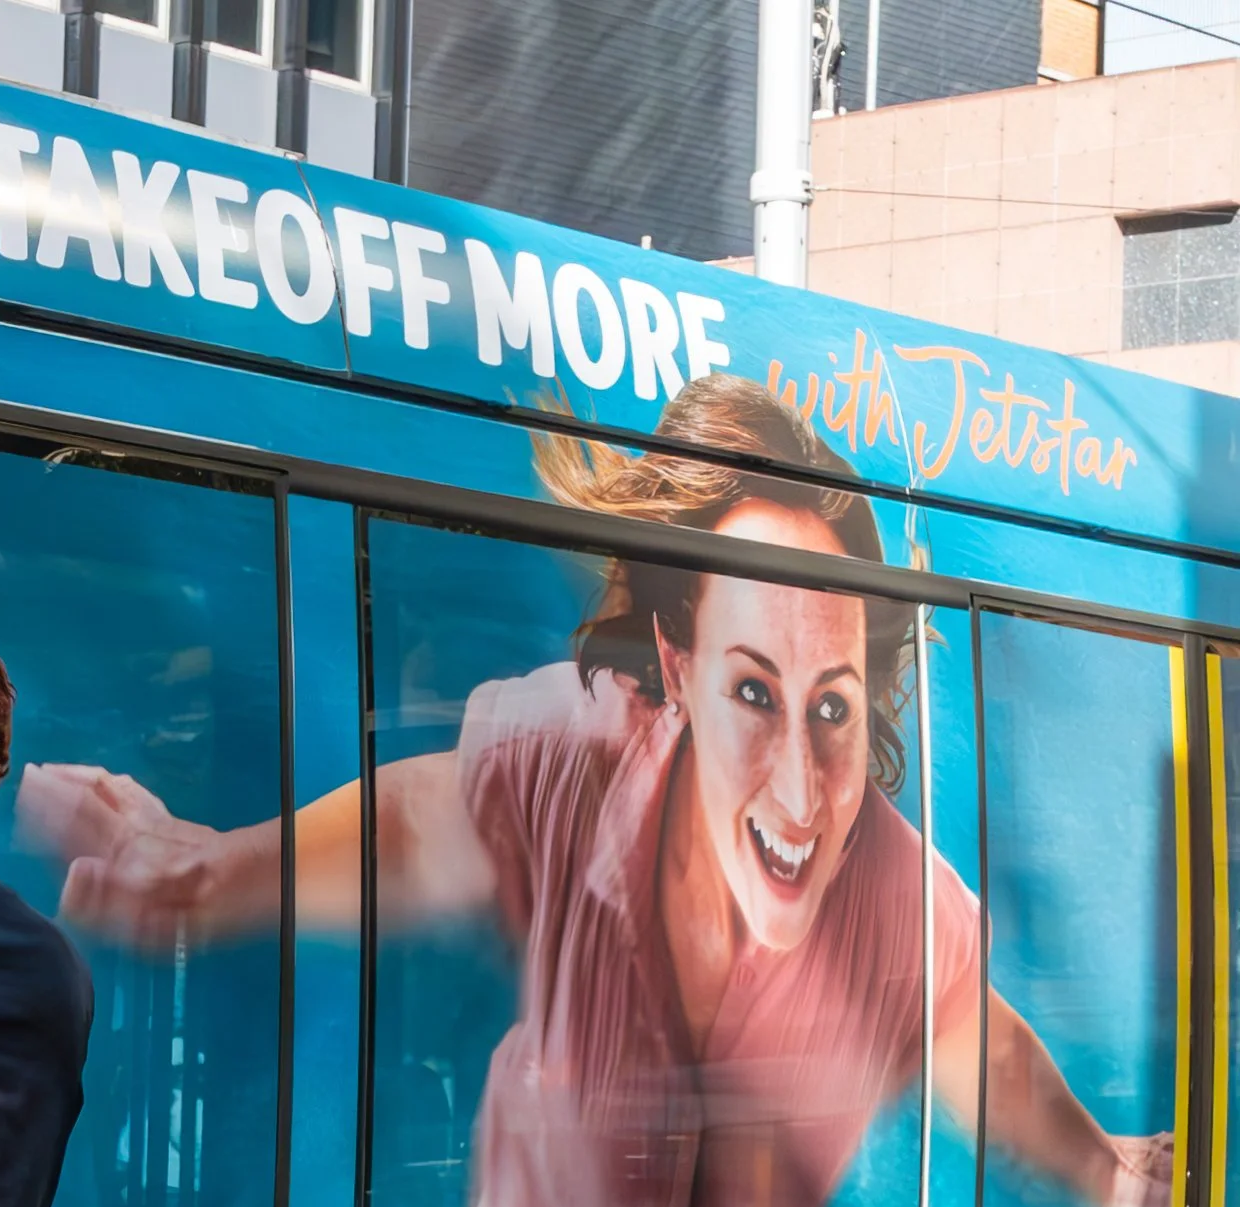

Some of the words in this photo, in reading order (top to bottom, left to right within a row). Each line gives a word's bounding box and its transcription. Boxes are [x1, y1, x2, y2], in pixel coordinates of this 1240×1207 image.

[464, 237, 731, 402] MORE
[767, 328, 899, 453] with
[893, 345, 1138, 497] Jetstar
